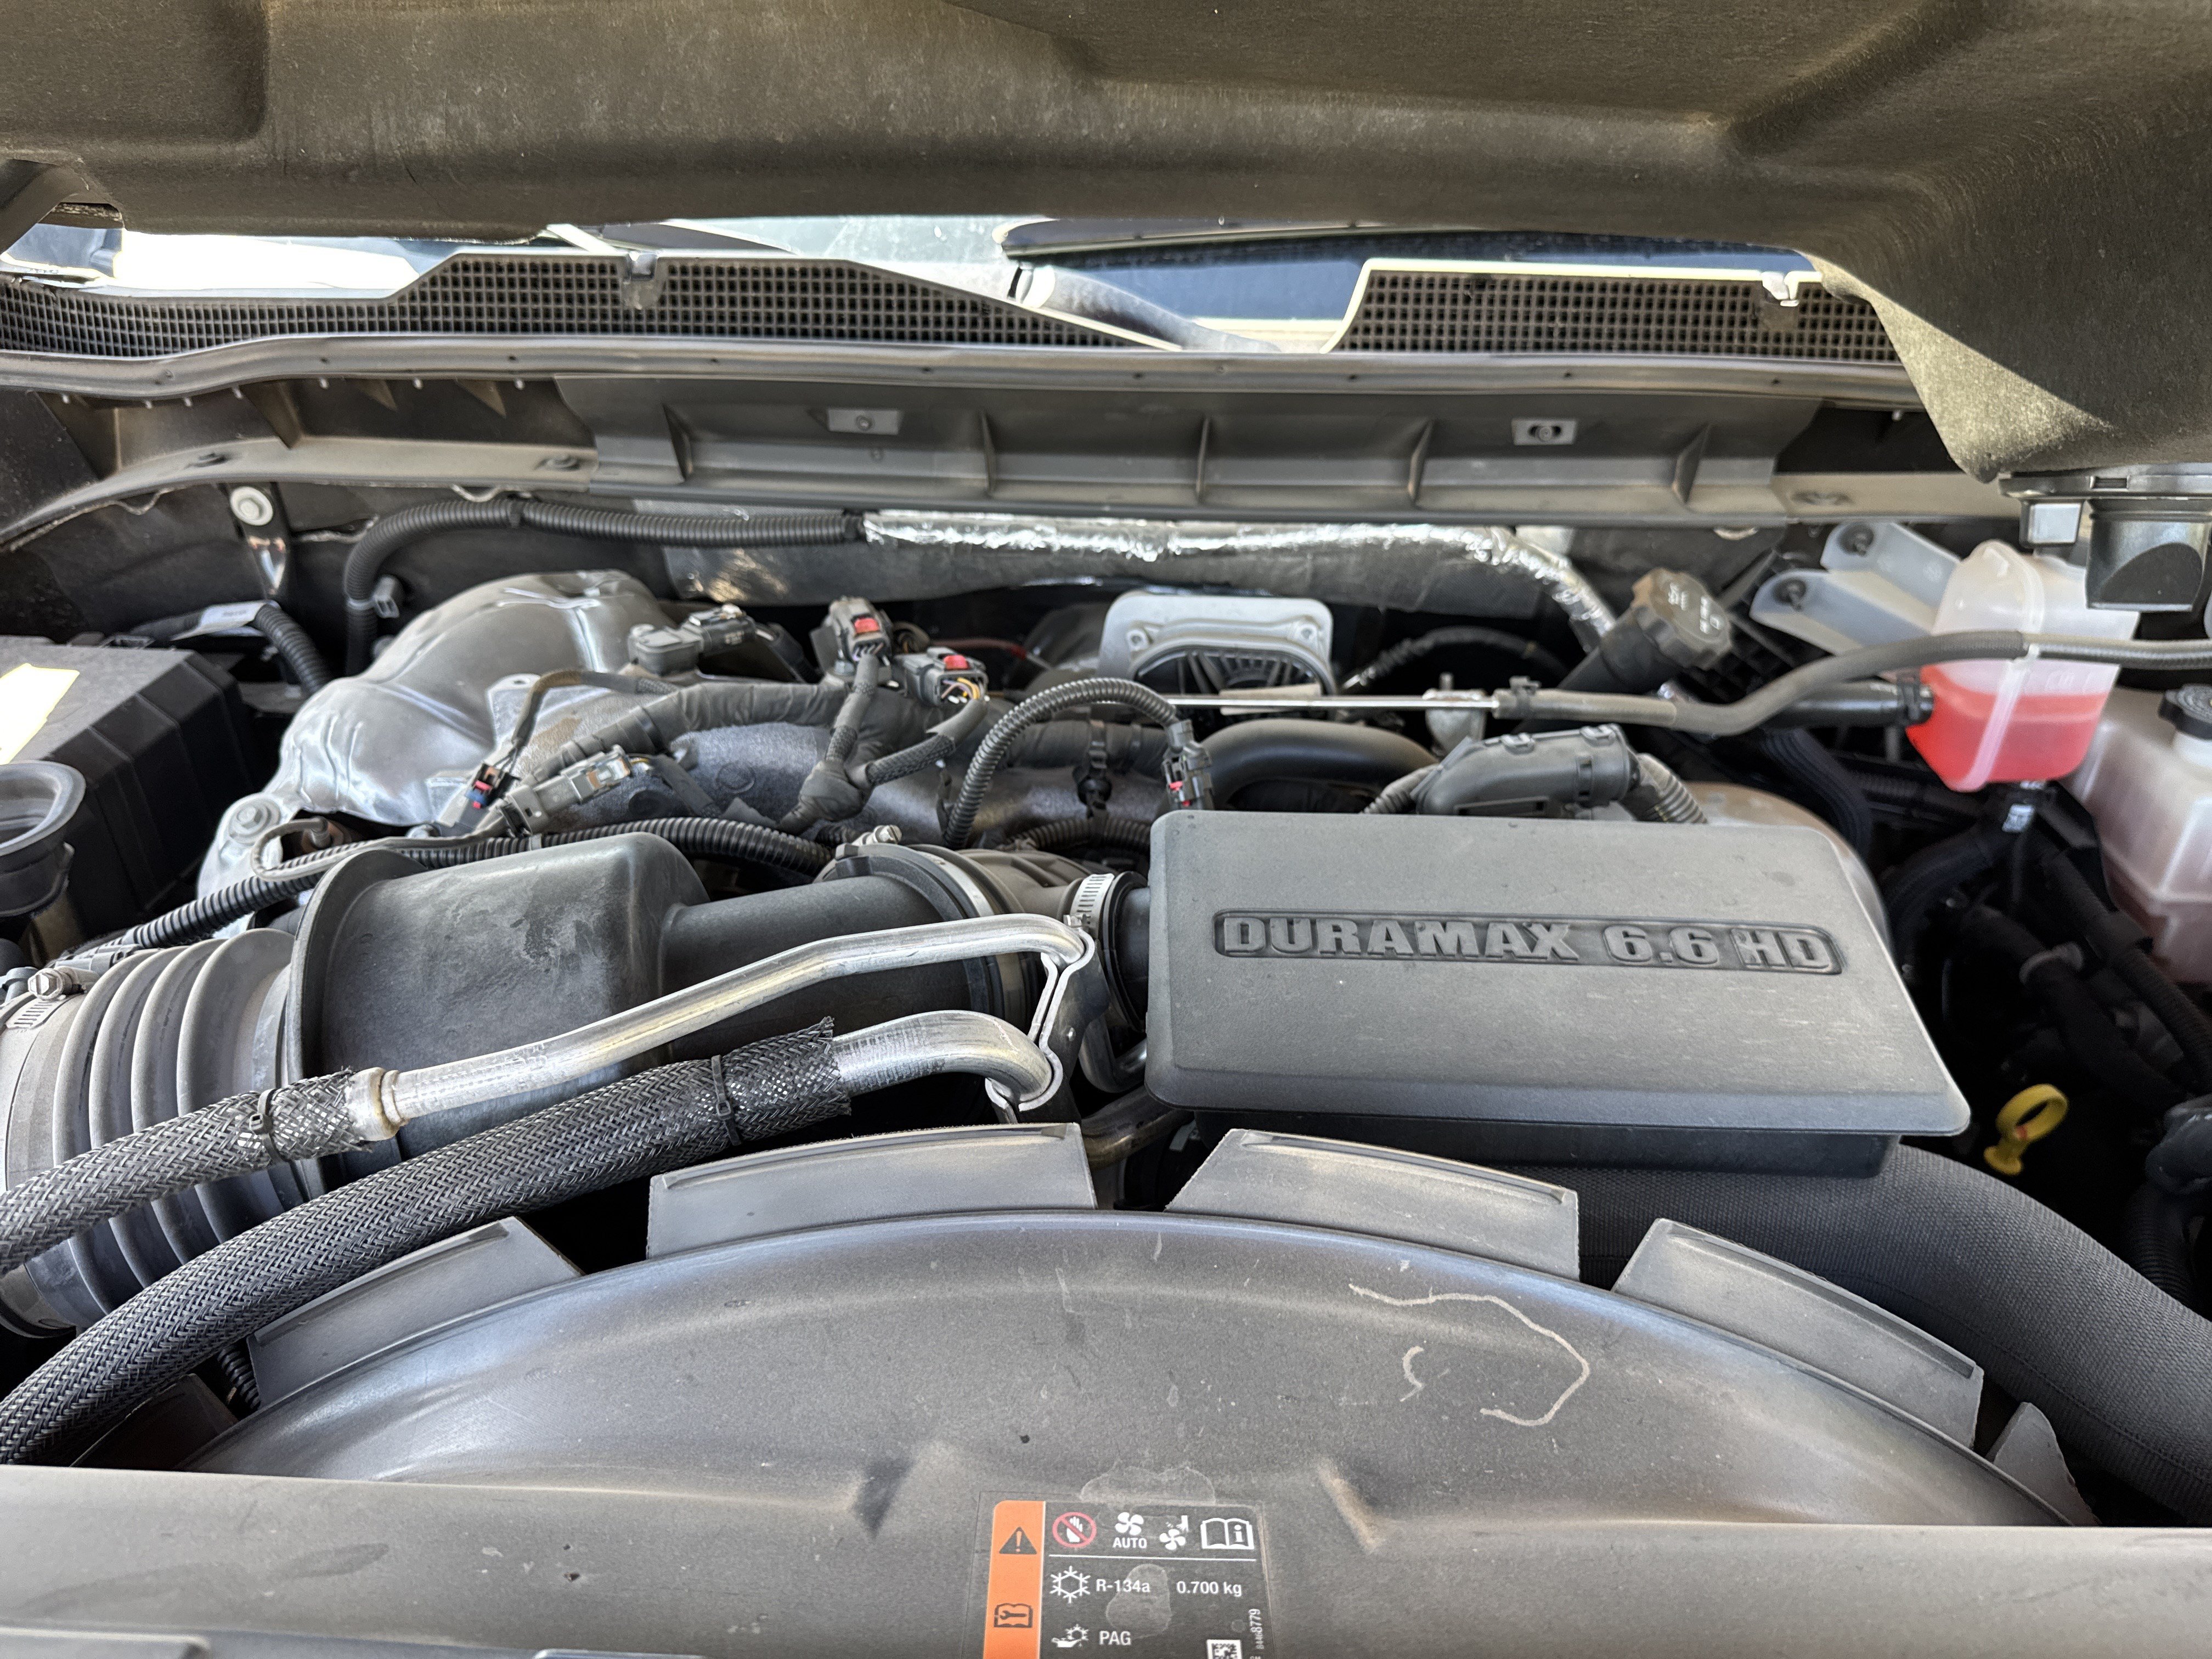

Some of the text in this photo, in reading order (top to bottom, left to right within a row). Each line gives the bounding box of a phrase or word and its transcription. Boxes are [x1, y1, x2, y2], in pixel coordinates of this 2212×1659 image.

[1223, 917, 1830, 970] DURAMAX 6.6 HD
[1113, 1537, 1148, 1549] AUTO
[1096, 1578, 1243, 1598] R-134a 0.700 kg
[1099, 1630, 1132, 1646] PAG
